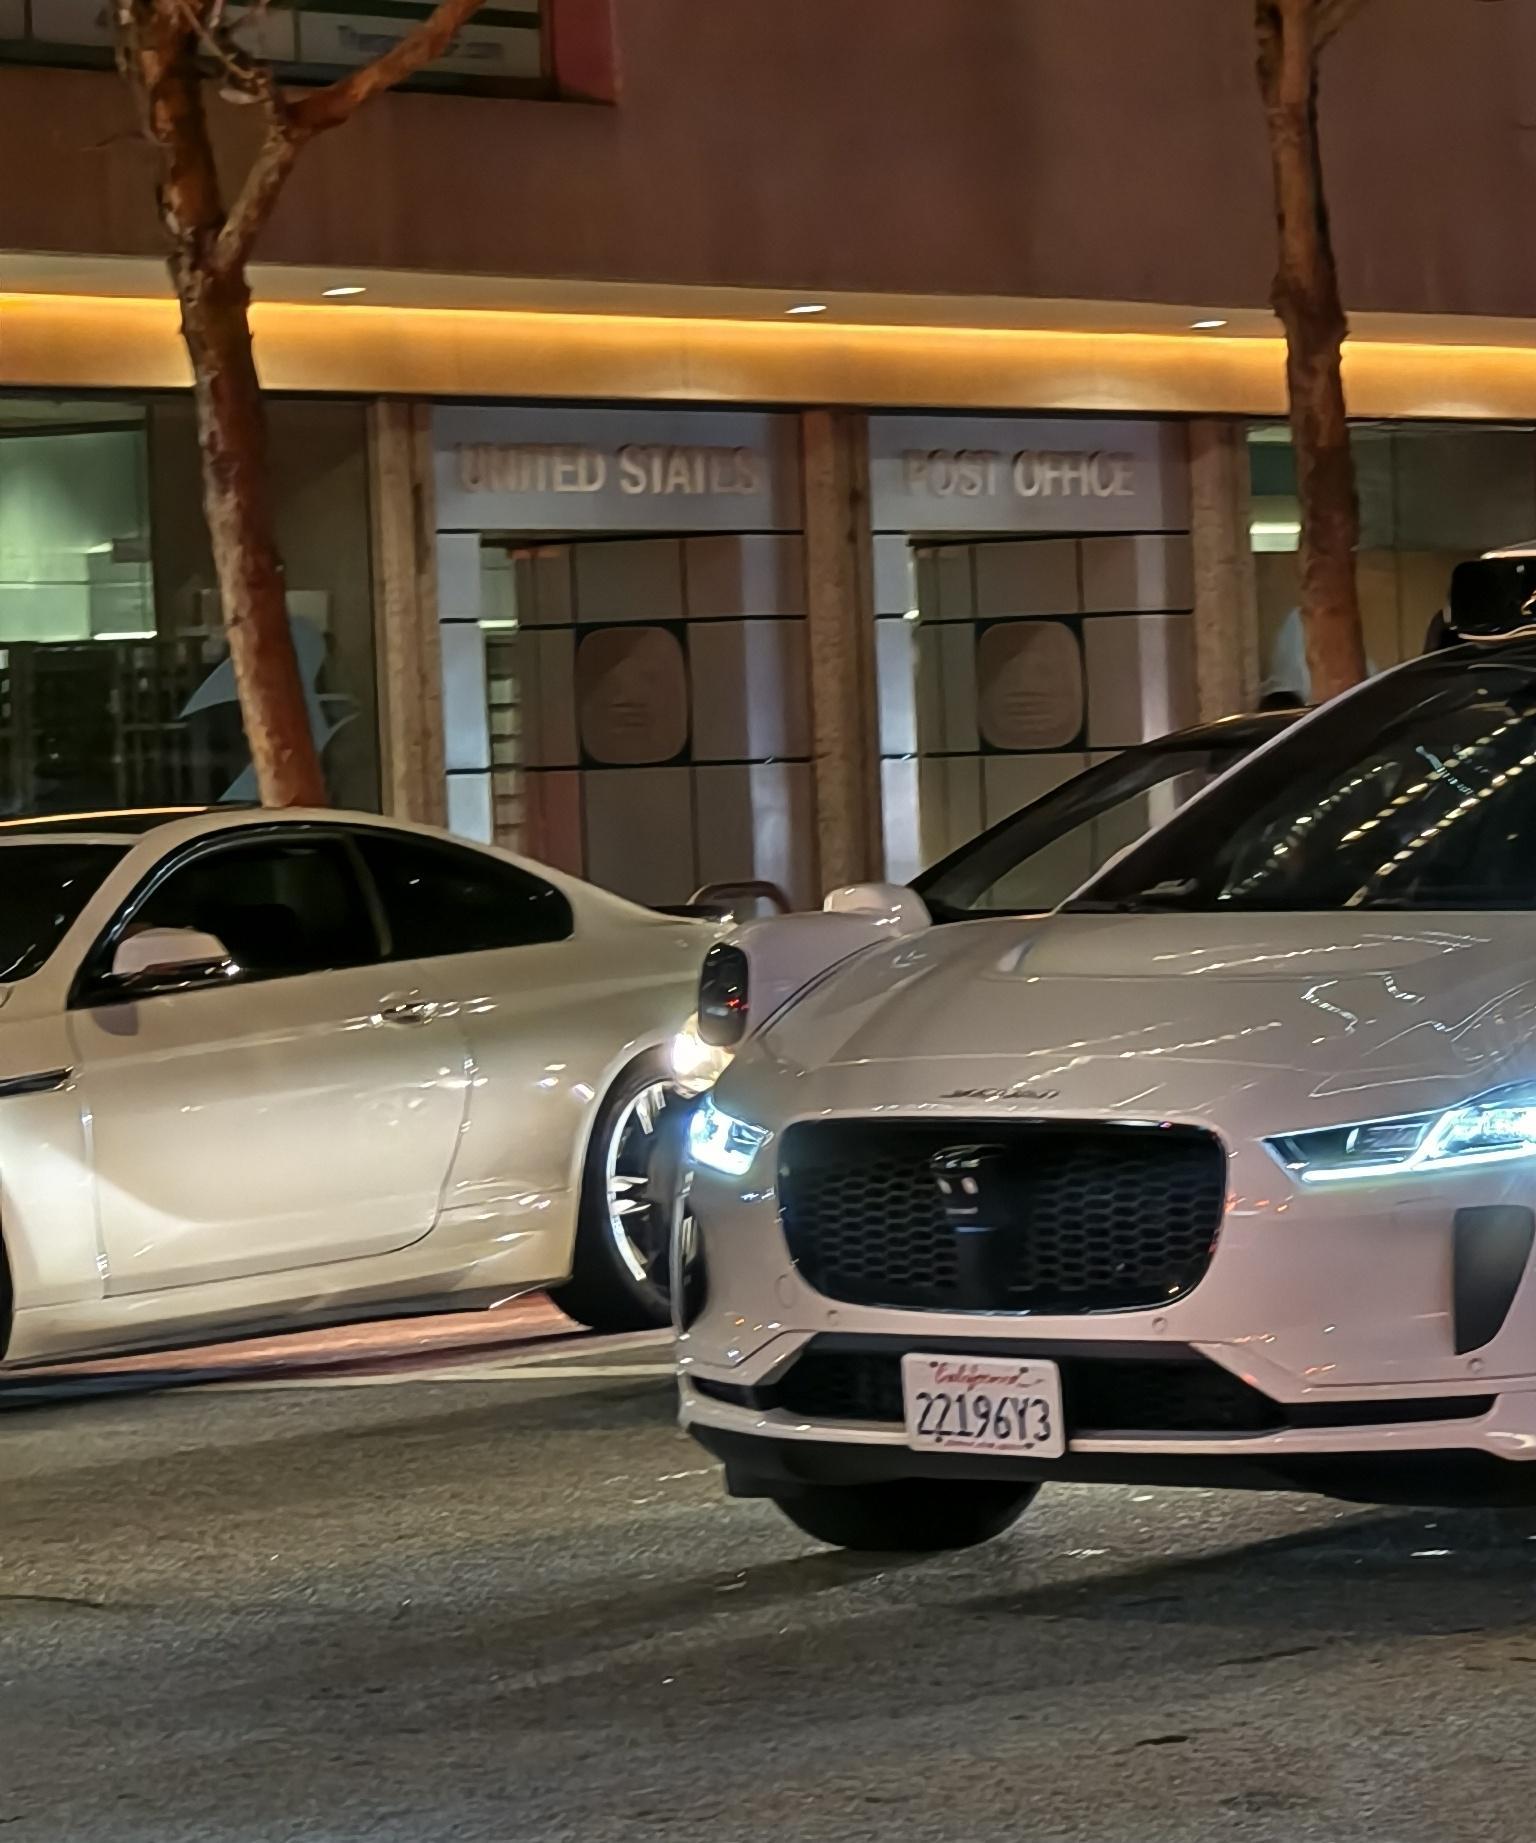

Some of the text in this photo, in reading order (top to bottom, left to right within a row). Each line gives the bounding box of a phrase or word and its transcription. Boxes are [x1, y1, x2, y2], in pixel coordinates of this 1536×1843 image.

[458, 442, 762, 494] UNITED STATES
[904, 449, 1136, 497] POST OFFICE
[916, 1391, 1052, 1441] 22196Y3
